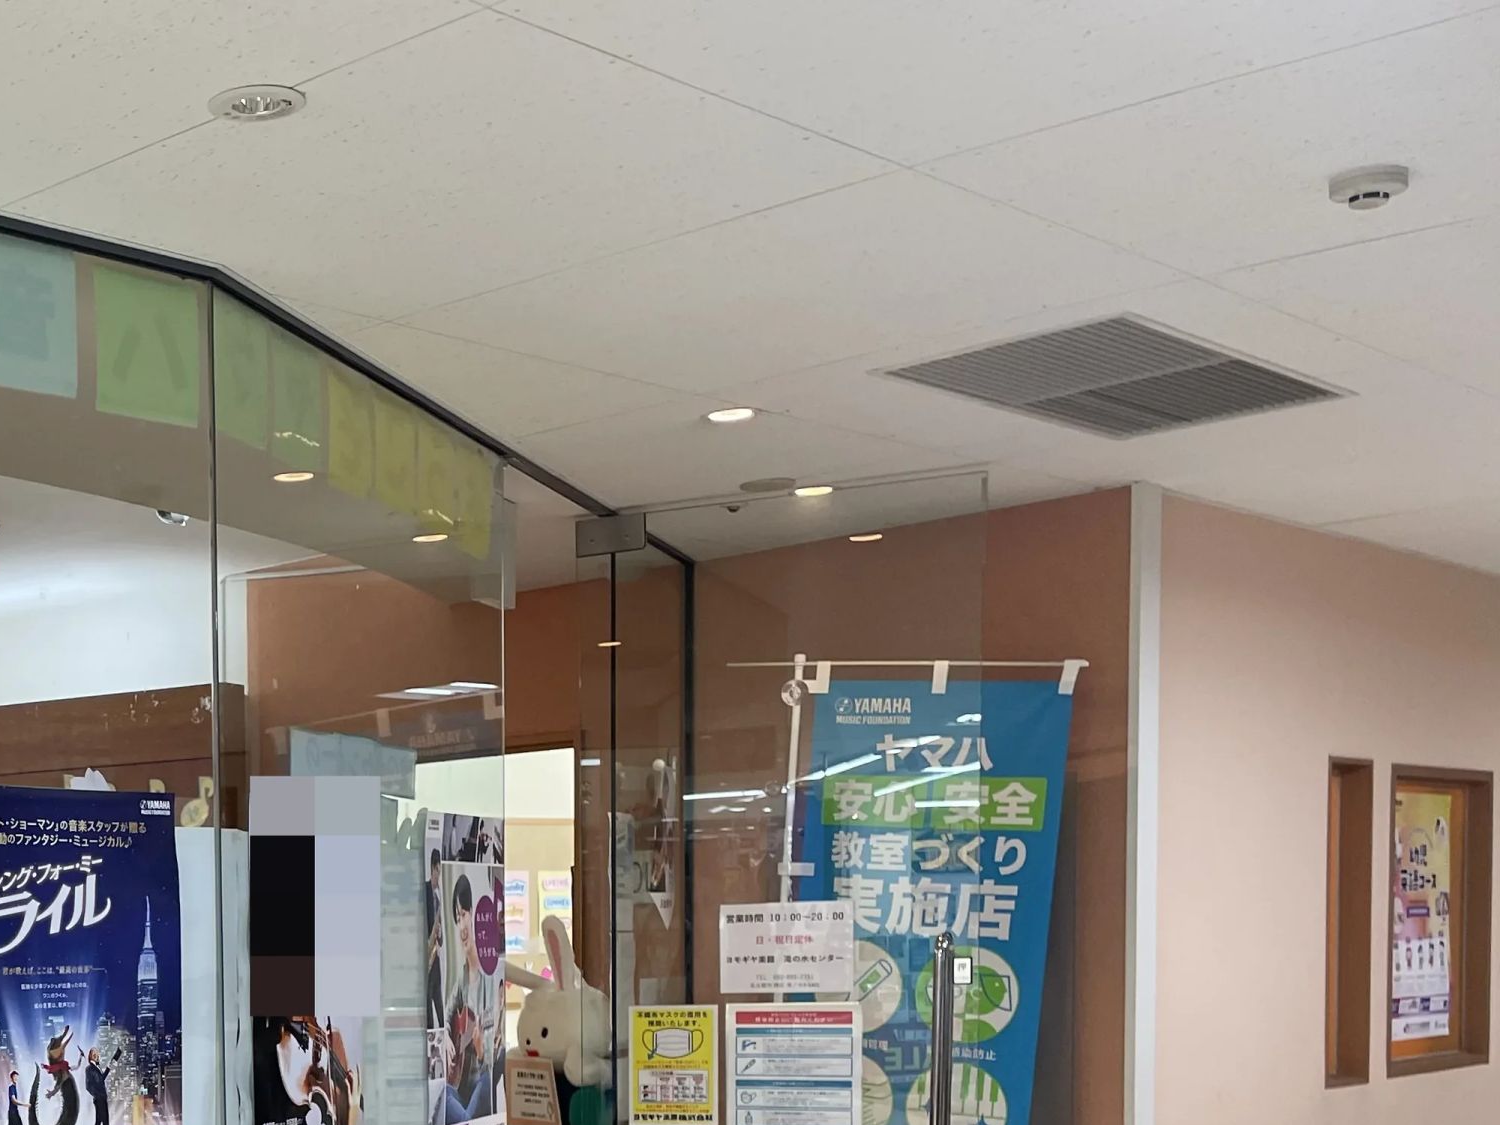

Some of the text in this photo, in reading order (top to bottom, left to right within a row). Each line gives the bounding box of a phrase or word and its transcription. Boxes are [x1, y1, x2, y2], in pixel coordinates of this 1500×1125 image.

[853, 697, 912, 714] YAMAHA
[836, 715, 911, 725] MUSIC FOUNDATION
[875, 733, 994, 772] ヤマハ
[146, 800, 170, 810] YAMAHA
[833, 780, 1038, 826] 安心 安全
[830, 831, 1027, 876] 教室づくり
[726, 914, 764, 924] 営業時間
[832, 873, 1019, 941] 実施店
